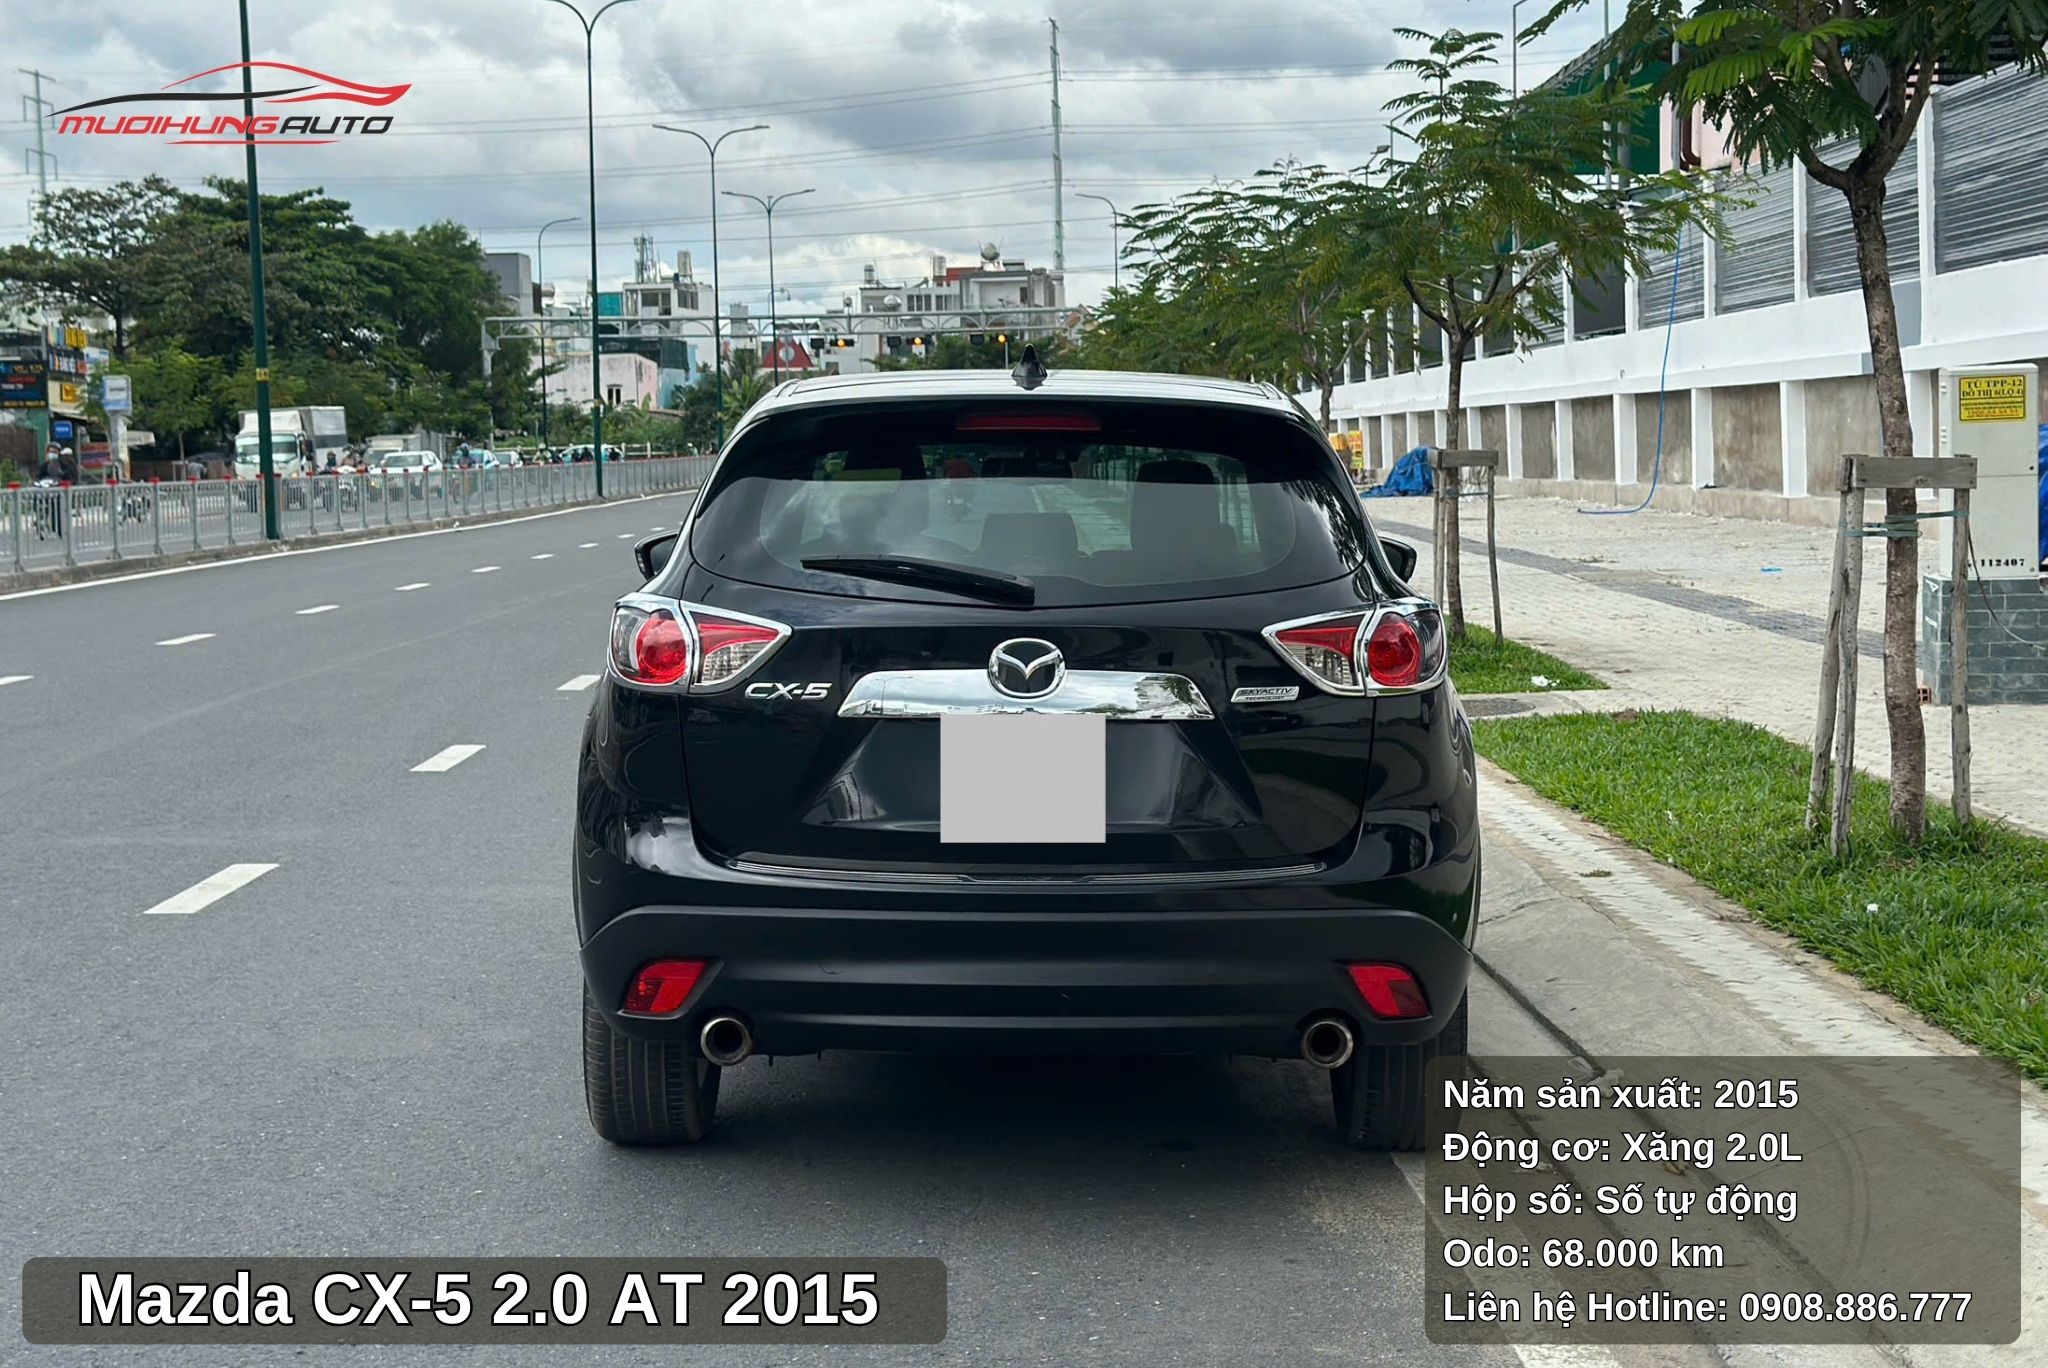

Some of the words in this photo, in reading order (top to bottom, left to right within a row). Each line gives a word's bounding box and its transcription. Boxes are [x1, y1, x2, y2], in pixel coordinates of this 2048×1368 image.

[1984, 379, 2022, 388] TPP-12
[1980, 558, 2025, 567] 112407
[744, 682, 833, 700] CX-5
[1239, 687, 1293, 695] SKYACTIV
